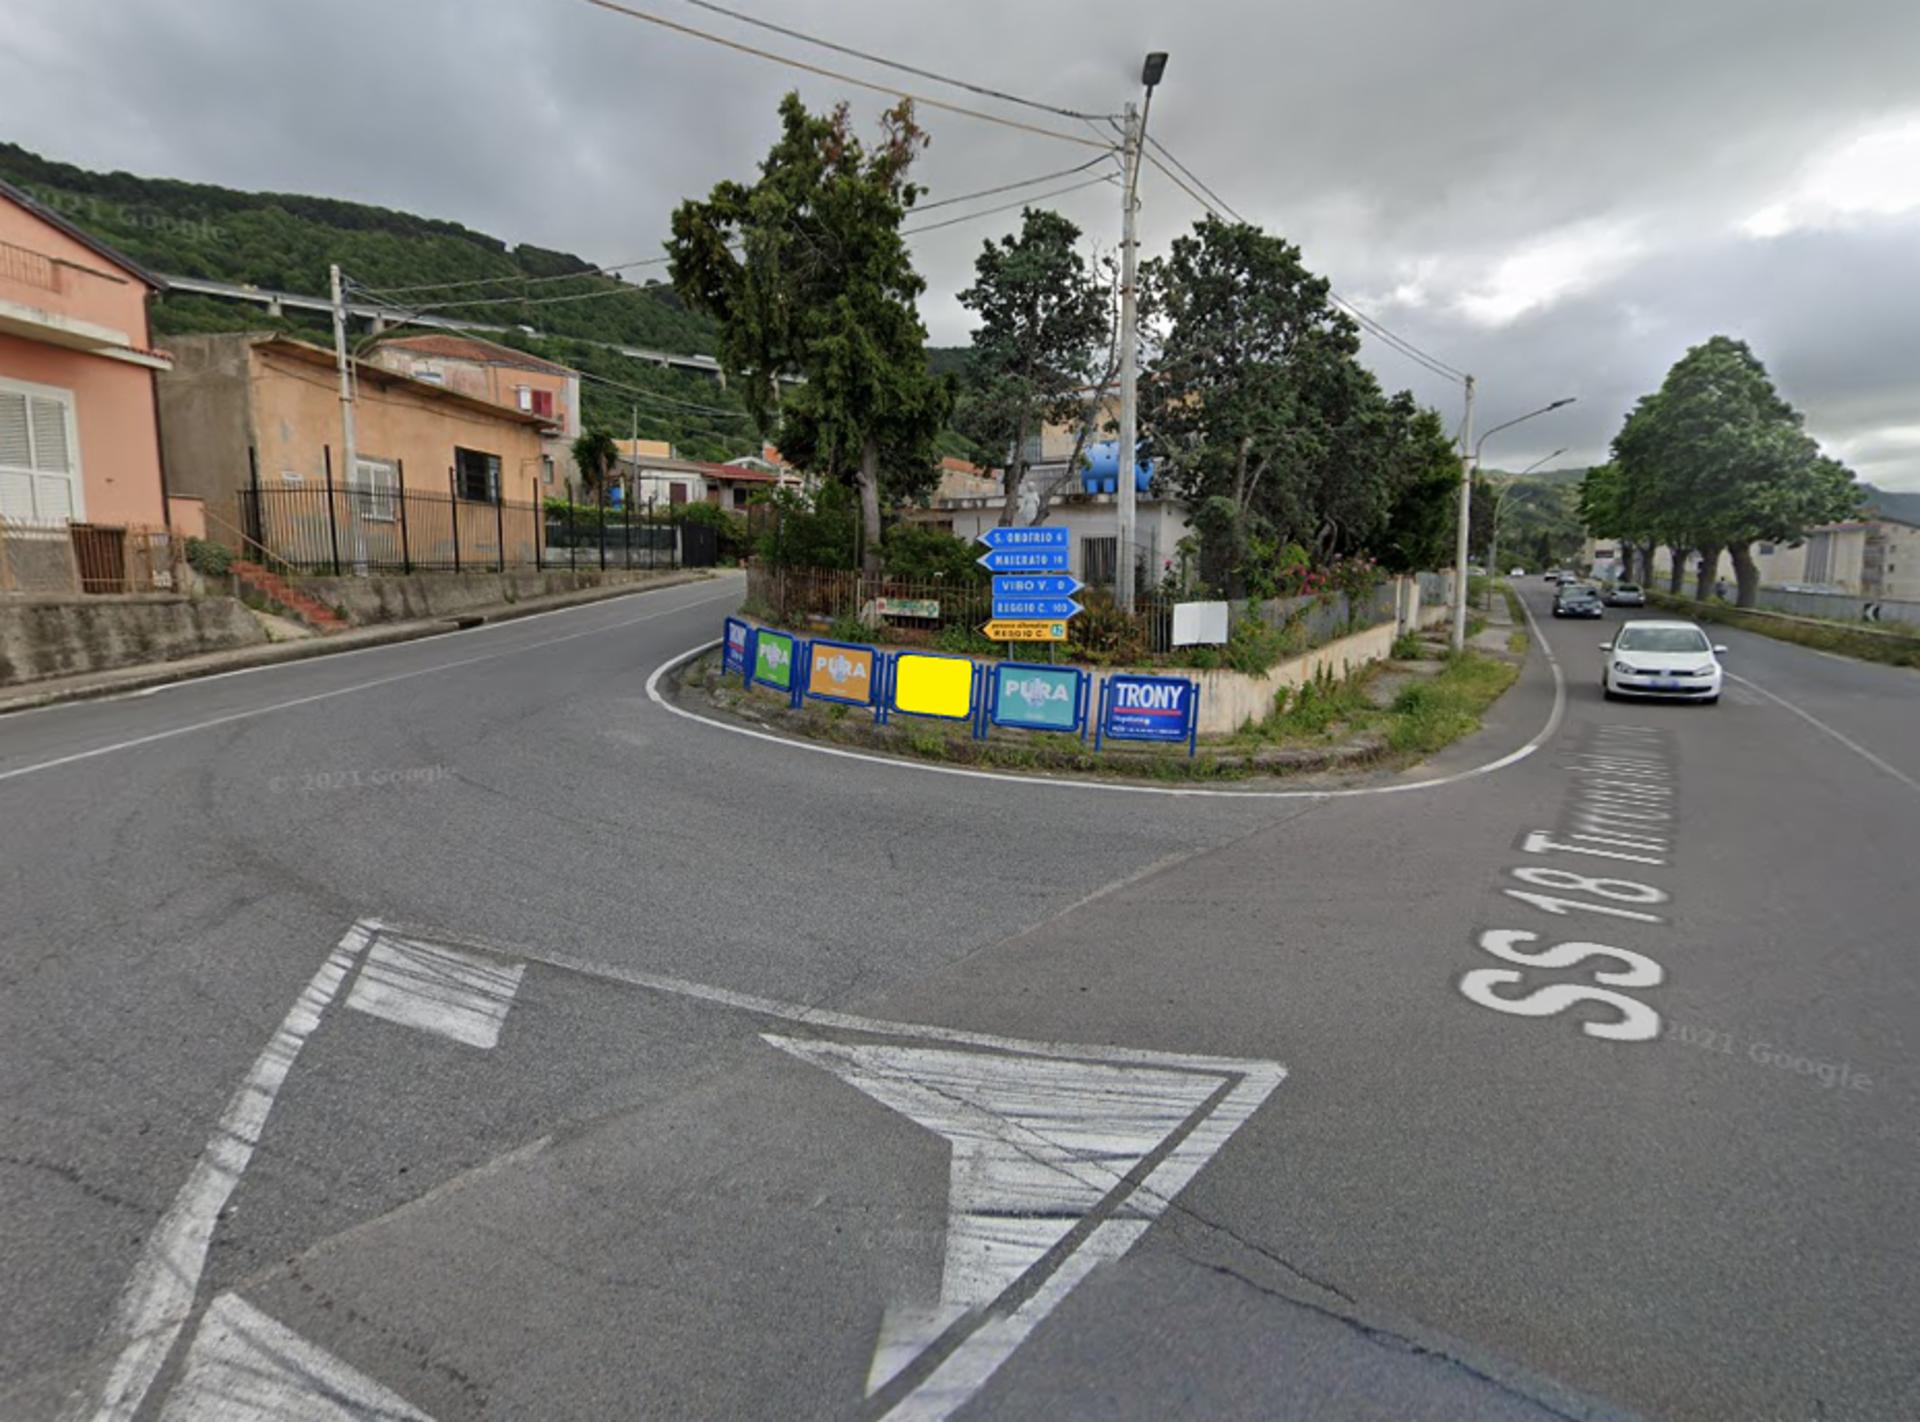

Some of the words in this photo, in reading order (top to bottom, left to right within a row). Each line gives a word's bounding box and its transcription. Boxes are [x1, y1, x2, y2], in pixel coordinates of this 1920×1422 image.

[1002, 581, 1034, 590] VIBO
[997, 603, 1035, 613] REGGIO
[994, 629, 1033, 637] REGGIO
[1116, 682, 1184, 709] TRONY
